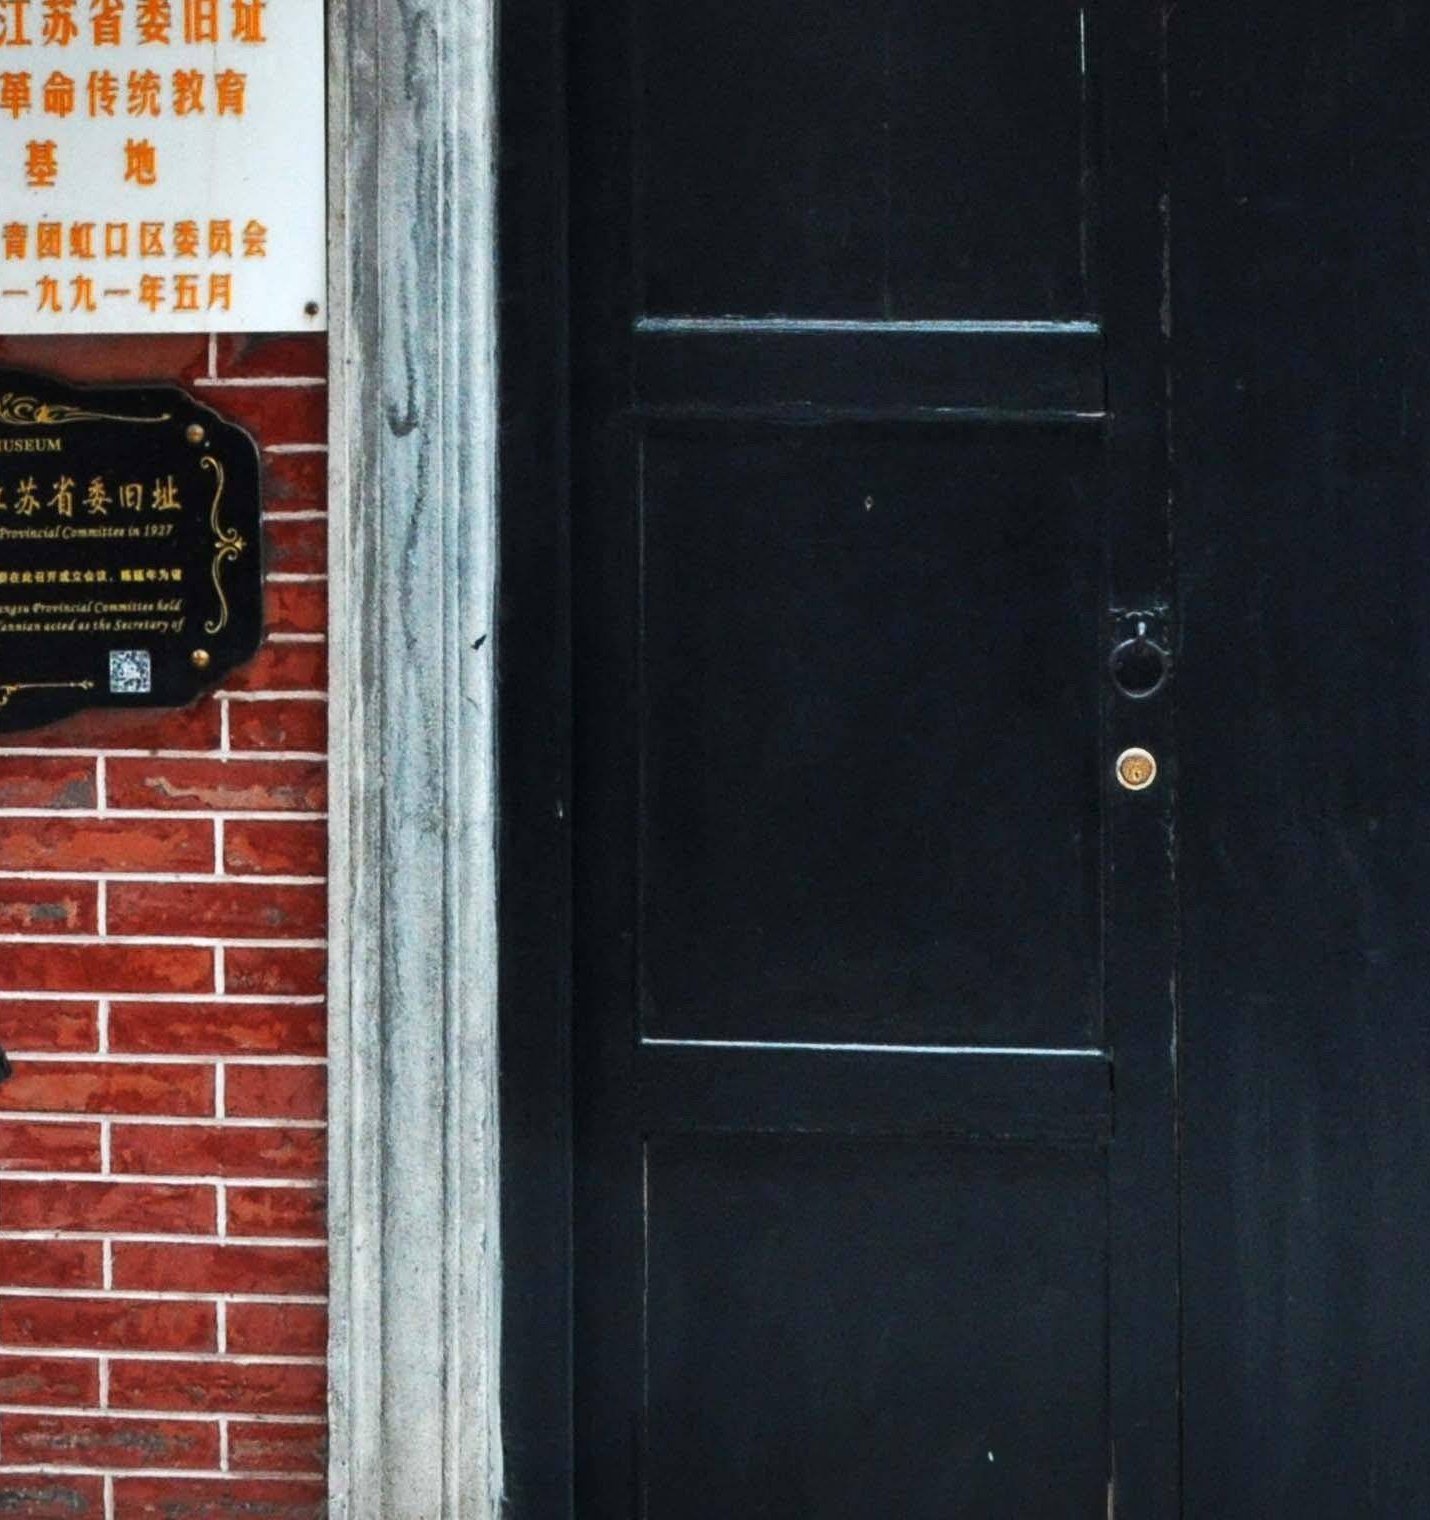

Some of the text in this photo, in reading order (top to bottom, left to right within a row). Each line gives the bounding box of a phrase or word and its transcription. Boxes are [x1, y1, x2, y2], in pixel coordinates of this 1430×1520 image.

[1, 273, 234, 314] 一九九一年五月
[62, 525, 124, 539] Committee
[128, 526, 139, 536] in
[143, 524, 174, 537] 1927
[32, 601, 92, 613] Provincial
[94, 601, 154, 613] Committee
[157, 598, 182, 612] held
[44, 618, 74, 631] acted
[78, 621, 91, 630] as
[93, 618, 112, 631] the
[114, 619, 168, 633] Secretary
[171, 616, 186, 633] of
